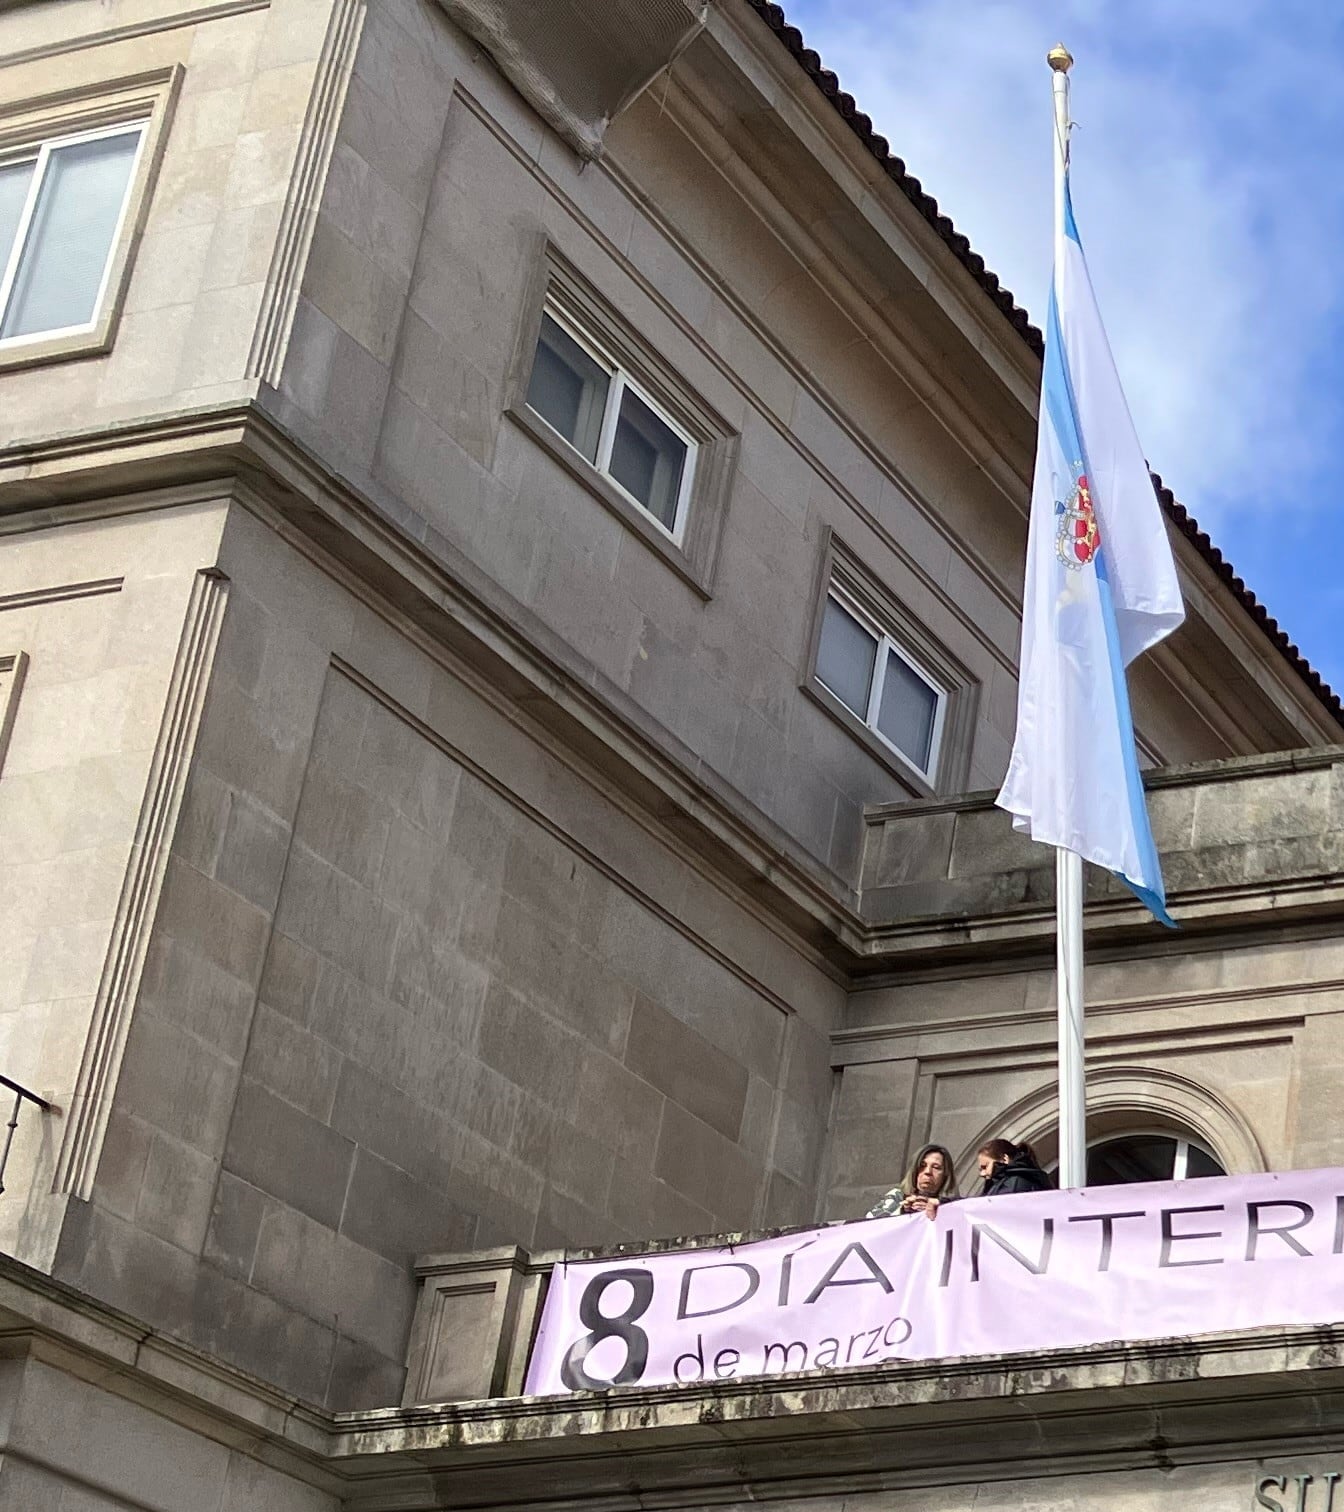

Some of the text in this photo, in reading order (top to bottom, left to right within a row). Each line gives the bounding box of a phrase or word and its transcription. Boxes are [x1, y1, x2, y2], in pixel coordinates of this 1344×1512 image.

[560, 1268, 655, 1392] 8
[676, 1239, 896, 1321] DÍA
[673, 1316, 913, 1384] de marzo
